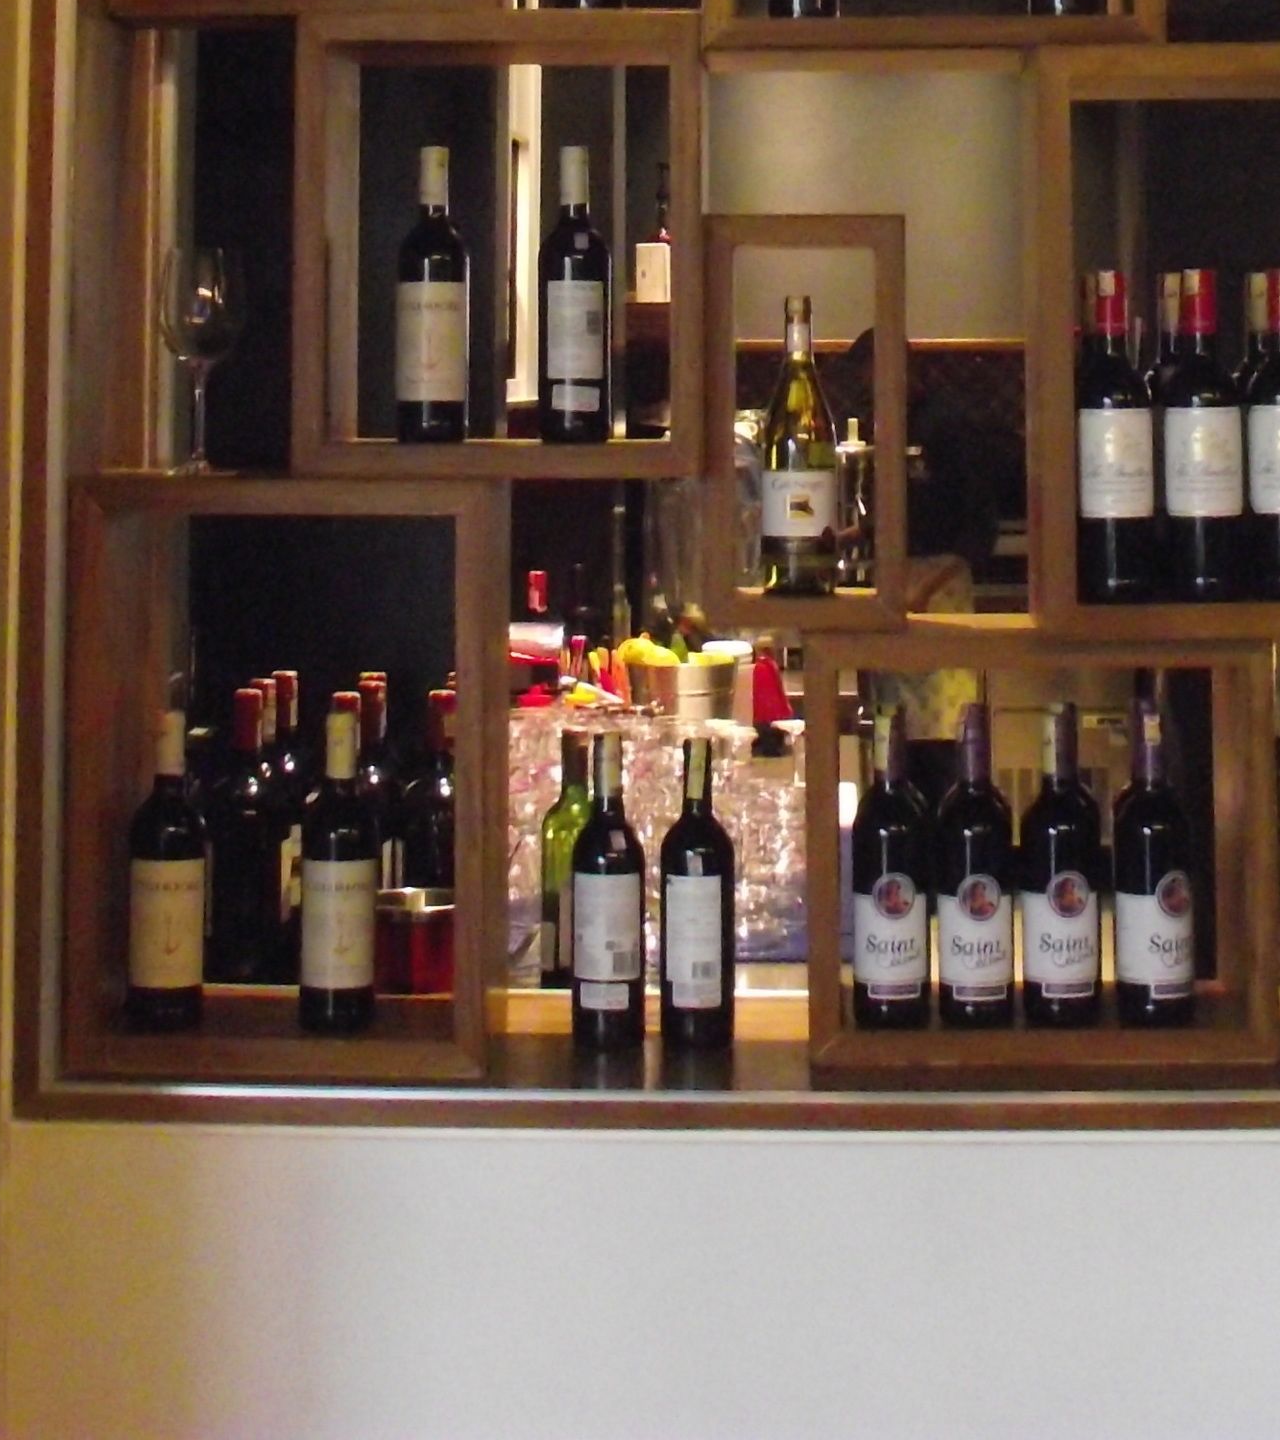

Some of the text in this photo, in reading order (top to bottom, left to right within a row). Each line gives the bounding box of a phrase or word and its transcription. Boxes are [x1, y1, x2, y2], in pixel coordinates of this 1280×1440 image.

[865, 932, 915, 953] Saint
[951, 934, 1001, 956] Saint
[1039, 932, 1091, 954] Saint
